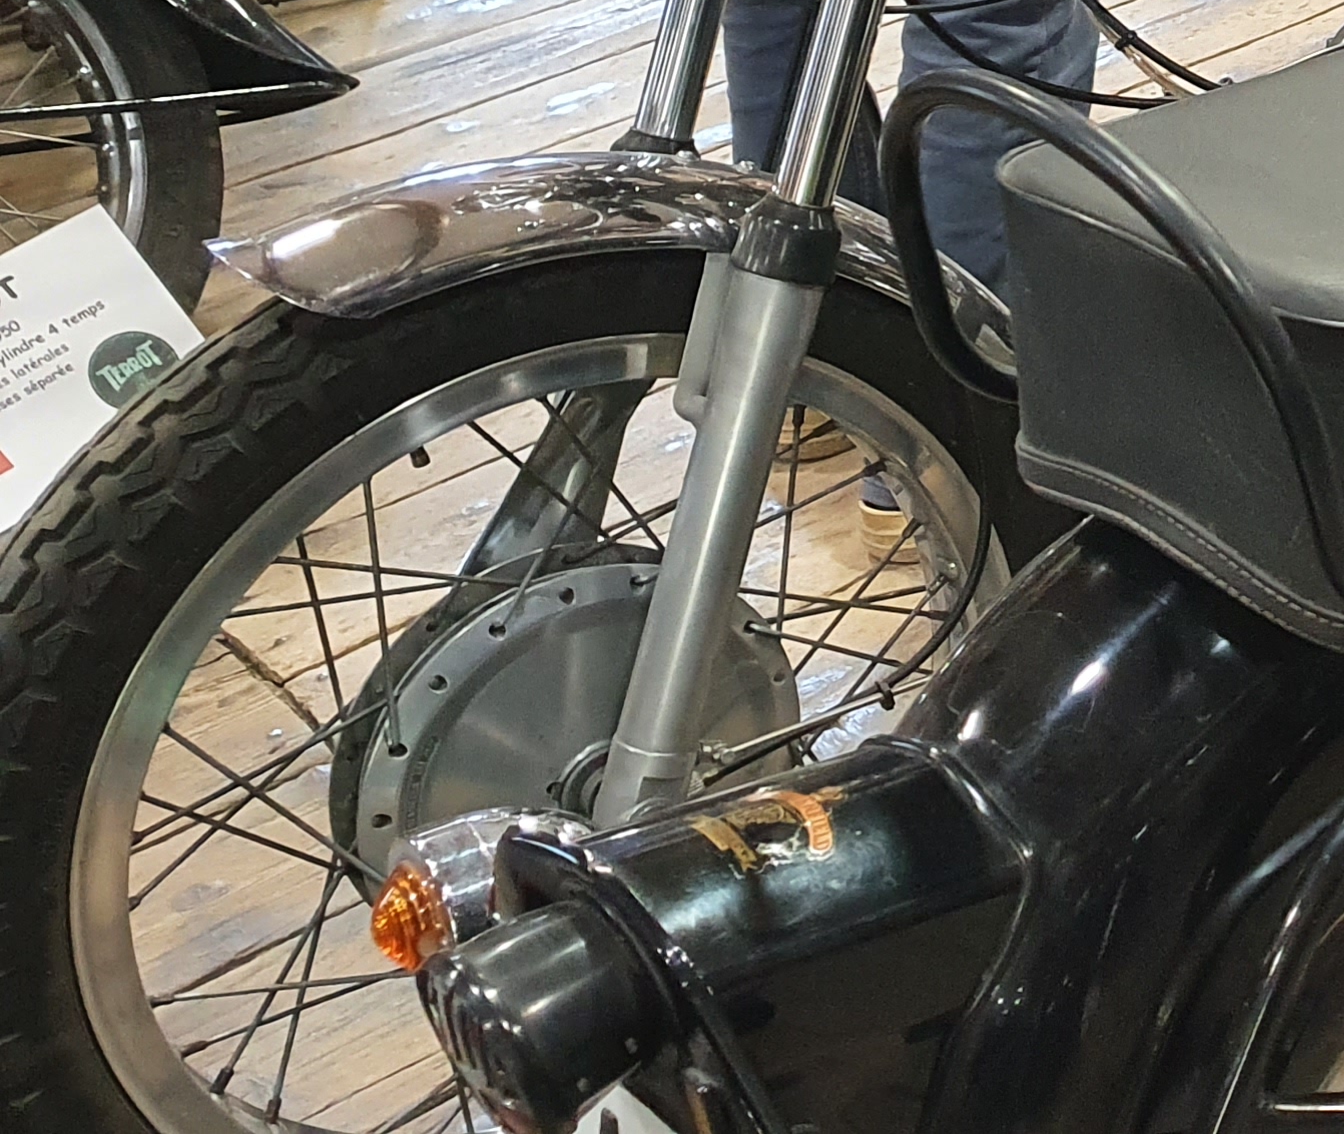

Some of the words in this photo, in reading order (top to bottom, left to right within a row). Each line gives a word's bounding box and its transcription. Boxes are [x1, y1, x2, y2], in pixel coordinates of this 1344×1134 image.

[0, 275, 18, 306] T
[48, 323, 60, 336] 4
[62, 300, 106, 328] temps
[12, 342, 71, 380] latérales
[95, 339, 163, 393] TERROT
[0, 393, 22, 412] ses
[23, 362, 75, 396] séparée
